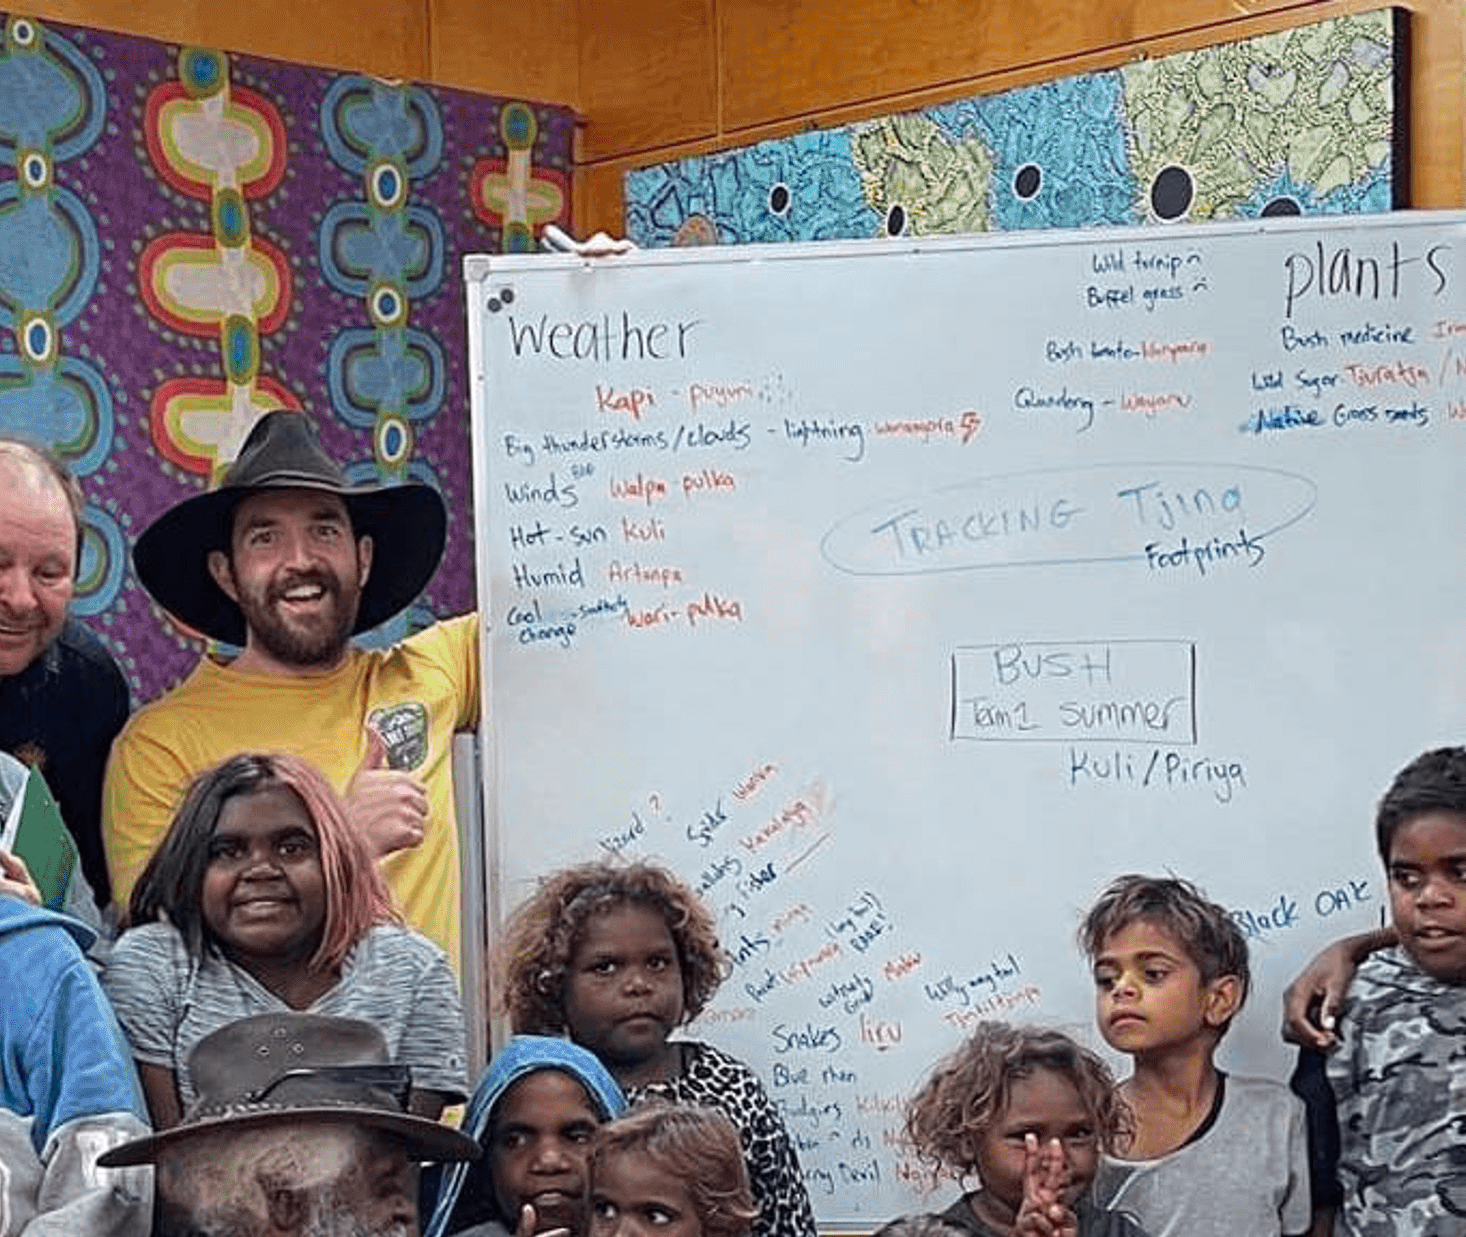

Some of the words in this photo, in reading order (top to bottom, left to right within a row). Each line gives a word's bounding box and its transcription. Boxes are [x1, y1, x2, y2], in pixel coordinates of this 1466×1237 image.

[1285, 240, 1453, 318] plants
[509, 310, 701, 361] Weather
[505, 472, 578, 507] Winds
[872, 499, 1085, 562] TRACKING
[1144, 529, 1266, 576] Footprints
[514, 557, 584, 588] Humid
[993, 643, 1112, 685] BUSH
